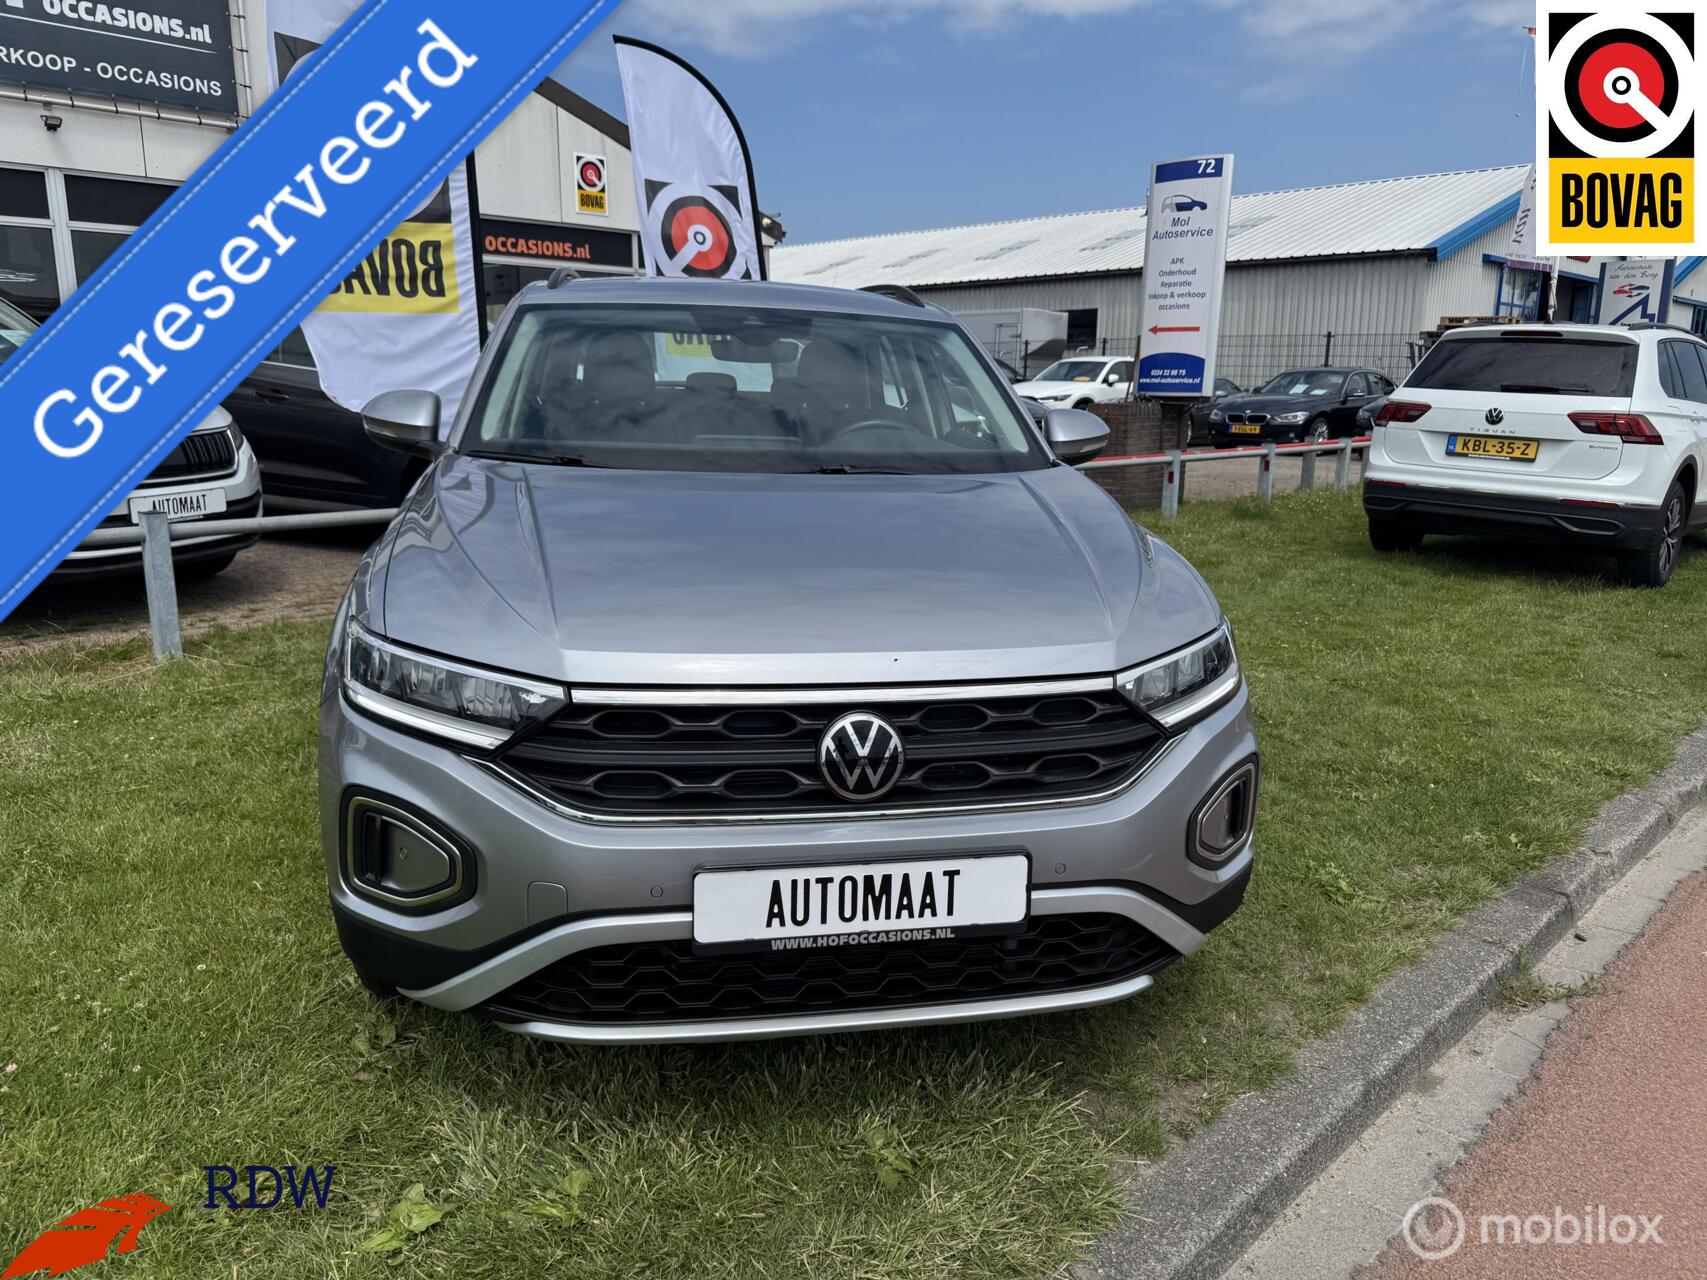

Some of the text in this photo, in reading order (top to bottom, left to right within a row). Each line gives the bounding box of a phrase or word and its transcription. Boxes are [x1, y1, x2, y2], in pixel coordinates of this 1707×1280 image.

[42, 0, 213, 44] OCCASIONS.nl
[96, 62, 222, 96] OCCASIONS
[1197, 159, 1216, 174] 72
[580, 193, 605, 210] BOVAG
[1171, 216, 1191, 228] Mol
[1152, 226, 1214, 241] Autoservice
[484, 235, 592, 260] OCCASIONS.nl
[1170, 257, 1185, 266] APK
[1158, 268, 1197, 278] Onderhoud
[1160, 279, 1193, 289] Reparatie
[1176, 290, 1207, 300] verkoop
[1158, 302, 1191, 311] occasions
[1461, 438, 1533, 457] KBL-35-Z
[765, 868, 961, 928] AUTOMAAT
[770, 927, 956, 951] WWW.HOFOCCASIONS.NL
